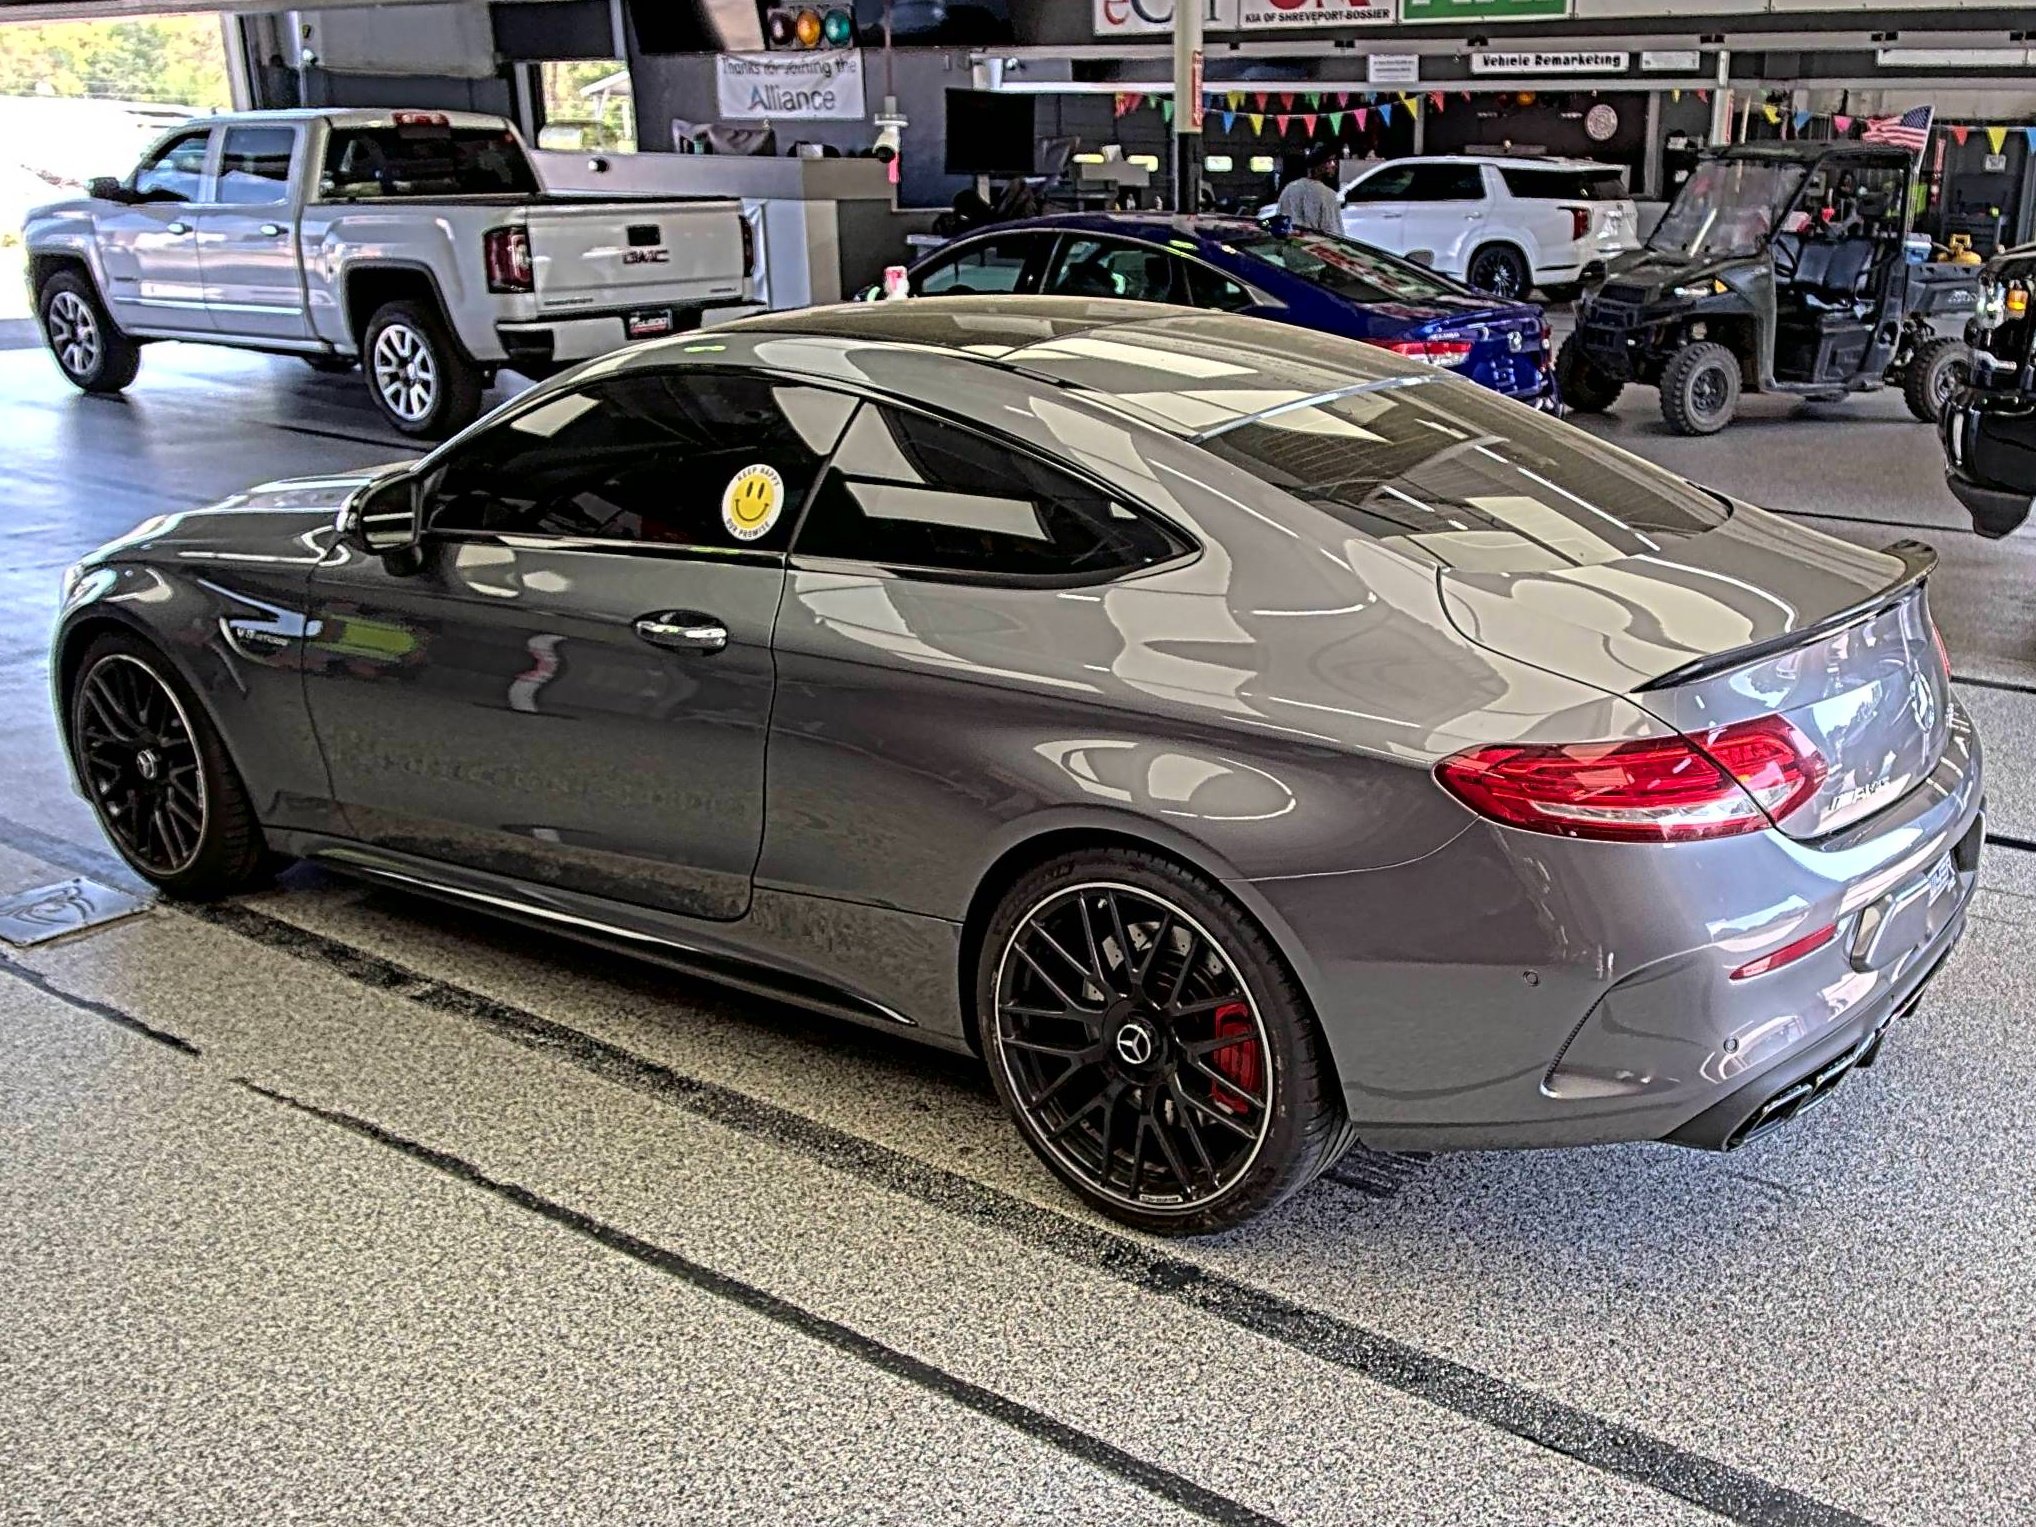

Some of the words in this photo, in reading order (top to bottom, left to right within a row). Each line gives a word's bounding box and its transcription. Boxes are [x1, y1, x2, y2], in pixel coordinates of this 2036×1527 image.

[1245, 13, 1261, 23] KIA
[1263, 12, 1276, 22] OF
[721, 57, 760, 75] Thanks
[834, 59, 857, 73] the
[1483, 54, 1530, 67] Vehicle
[1535, 53, 1621, 67] Remarketing
[747, 84, 836, 111] Alliance
